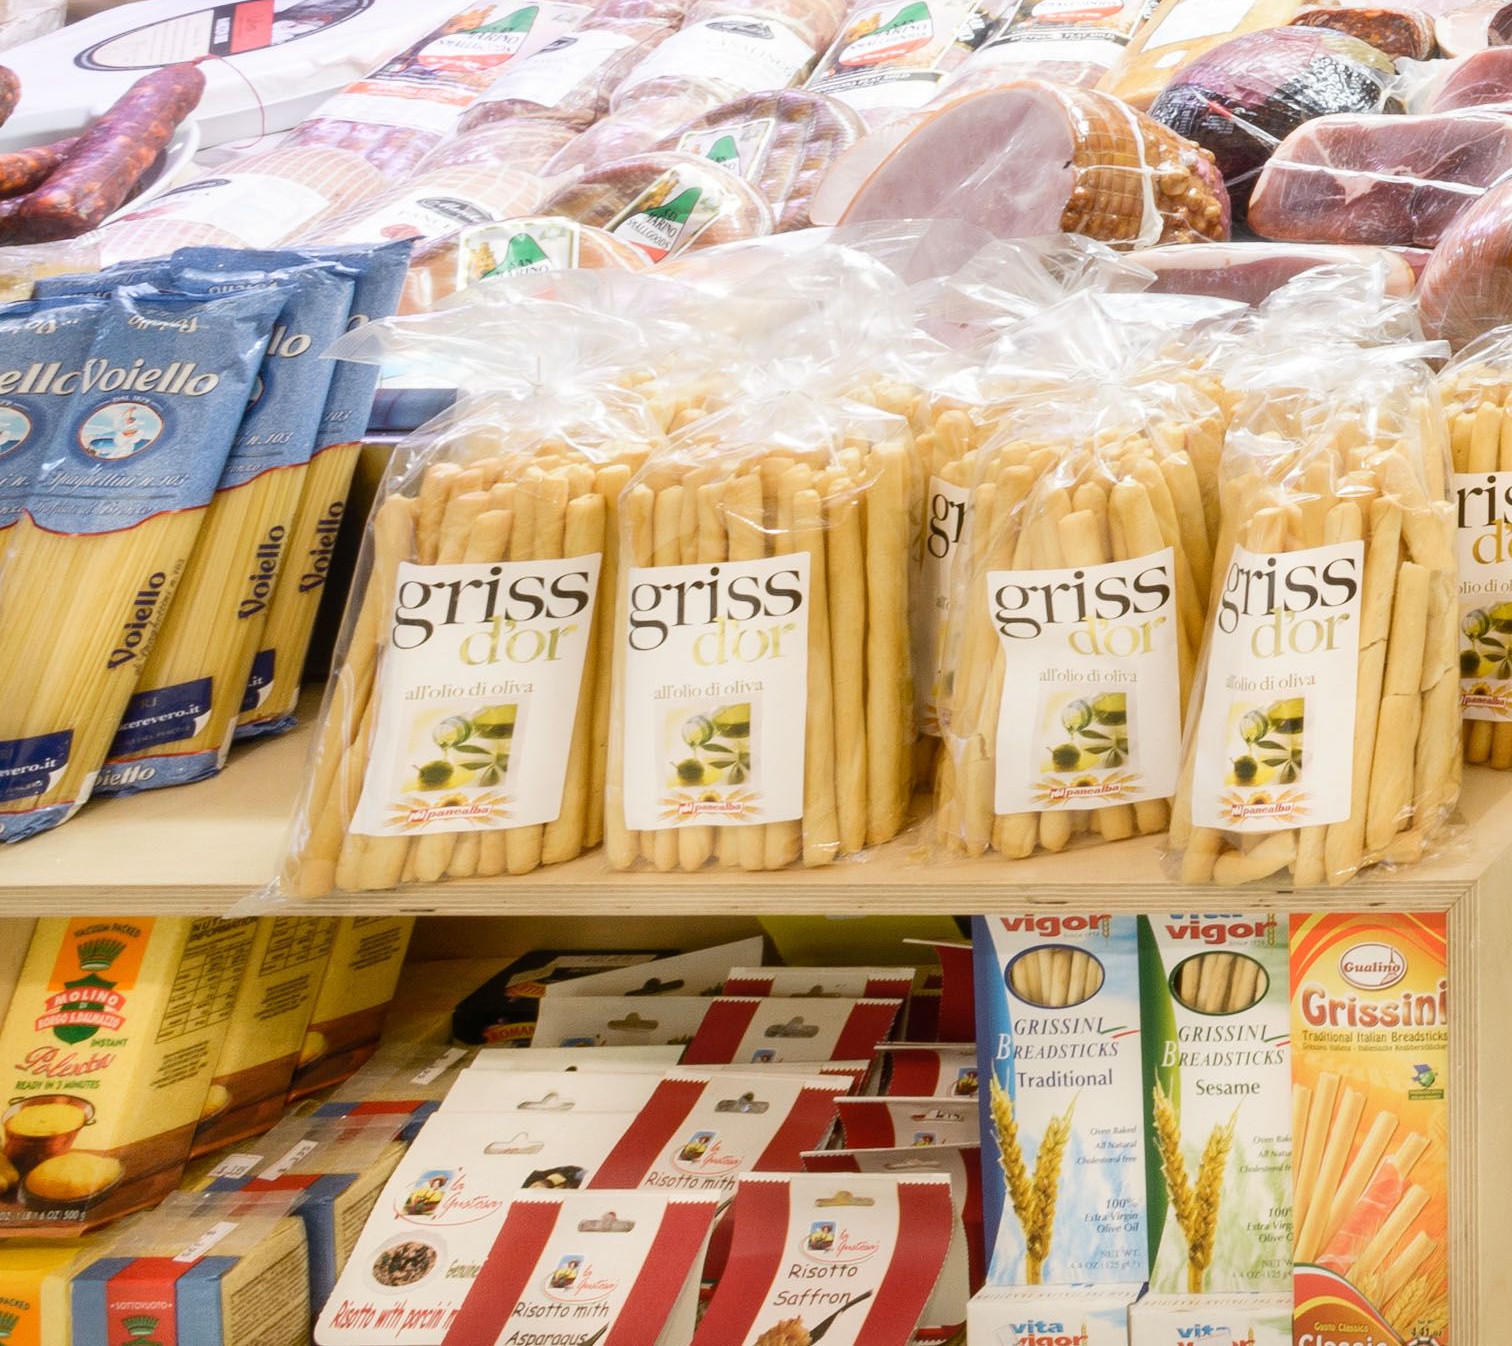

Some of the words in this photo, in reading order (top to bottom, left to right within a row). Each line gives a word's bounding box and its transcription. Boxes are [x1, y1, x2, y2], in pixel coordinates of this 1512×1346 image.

[81, 359, 221, 397] Voiello
[298, 501, 344, 594] Voiello
[238, 525, 285, 619] Voiello
[995, 565, 1171, 640] griss
[1219, 557, 1358, 635] griss
[392, 566, 590, 650] griss
[628, 567, 803, 651] griss
[108, 571, 166, 669] Voiello
[459, 614, 578, 667] d'or
[693, 615, 796, 667] d'or
[1067, 614, 1168, 659] d'or
[1250, 611, 1350, 660] d'or
[404, 682, 465, 701] all'olio
[469, 681, 488, 695] di
[491, 680, 534, 695] oliva
[653, 683, 702, 700] all'olio
[704, 681, 721, 695] di
[723, 680, 764, 694] oliva
[1000, 914, 1112, 937] vigor
[1165, 921, 1278, 944] vigor
[1344, 961, 1401, 973] Gualino
[54, 987, 120, 1006] MOLINO
[1302, 980, 1448, 1027] Grissini
[1014, 1017, 1104, 1035] GRISSINI
[1178, 1024, 1267, 1043] GRISSINI
[1302, 1030, 1353, 1042] Traditional
[1357, 1032, 1387, 1042] Italian
[1391, 1030, 1448, 1042] Breadsticks
[90, 1038, 128, 1047] INSTANT
[996, 1033, 1119, 1060] BREADSTICKS
[1163, 1040, 1284, 1067] BREADSTICKS
[15, 1081, 41, 1090] READY
[45, 1081, 53, 1089] IN
[65, 1080, 100, 1089] MINUTES
[1016, 1068, 1113, 1088] Traditional
[1195, 1079, 1260, 1095] Sesame
[788, 1263, 858, 1279] Risotto
[774, 1289, 850, 1307] Saffron
[331, 1301, 374, 1329] Risotto
[376, 1300, 404, 1329] with
[405, 1303, 442, 1337] porcini
[512, 1302, 571, 1318] Risotto
[573, 1302, 609, 1318] mith
[506, 1331, 588, 1346] Asparagus
